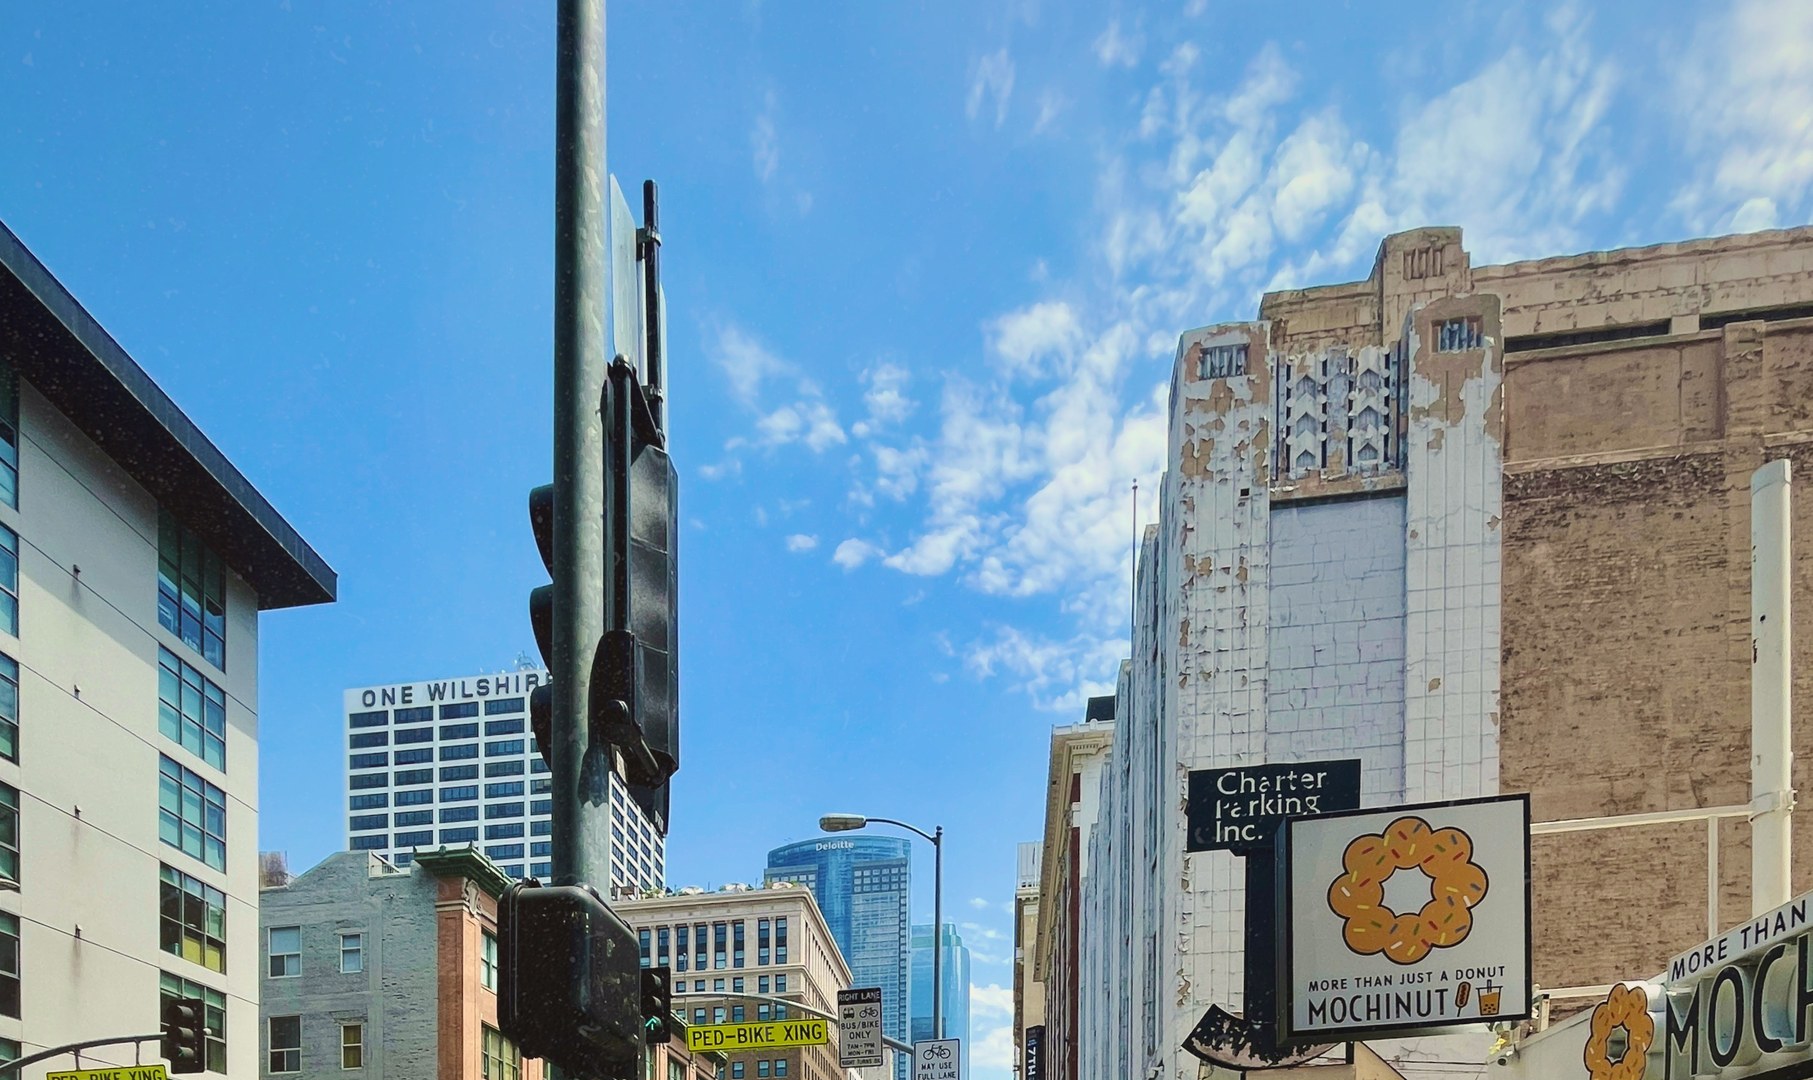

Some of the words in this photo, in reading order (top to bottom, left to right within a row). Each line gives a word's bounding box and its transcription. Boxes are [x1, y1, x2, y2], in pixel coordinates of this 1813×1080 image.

[362, 685, 413, 708] ONE
[1216, 770, 1327, 795] Charter
[1215, 793, 1321, 819] Parking
[1215, 820, 1263, 843] Inc.
[815, 840, 855, 852] Deloitte
[1671, 937, 1728, 982] MORE
[1740, 899, 1806, 950] THAN
[1308, 978, 1348, 993] MORE
[1354, 975, 1393, 988] THAN
[1399, 971, 1433, 985] JUST
[1440, 970, 1448, 982] A
[1455, 965, 1505, 980] DONUT
[838, 992, 858, 1002] RIGHT
[860, 991, 880, 1000] LANE
[1308, 988, 1449, 1026] MOCHINUT
[692, 1026, 776, 1047] PED-BIKE
[783, 1023, 822, 1042] XING
[840, 1020, 879, 1030] BUS/BIKE
[849, 1030, 872, 1040] ONLY
[917, 1073, 934, 1080] FULL
[938, 1071, 956, 1079] LANE
[921, 1062, 935, 1071] MAY
[939, 1061, 953, 1070] USE
